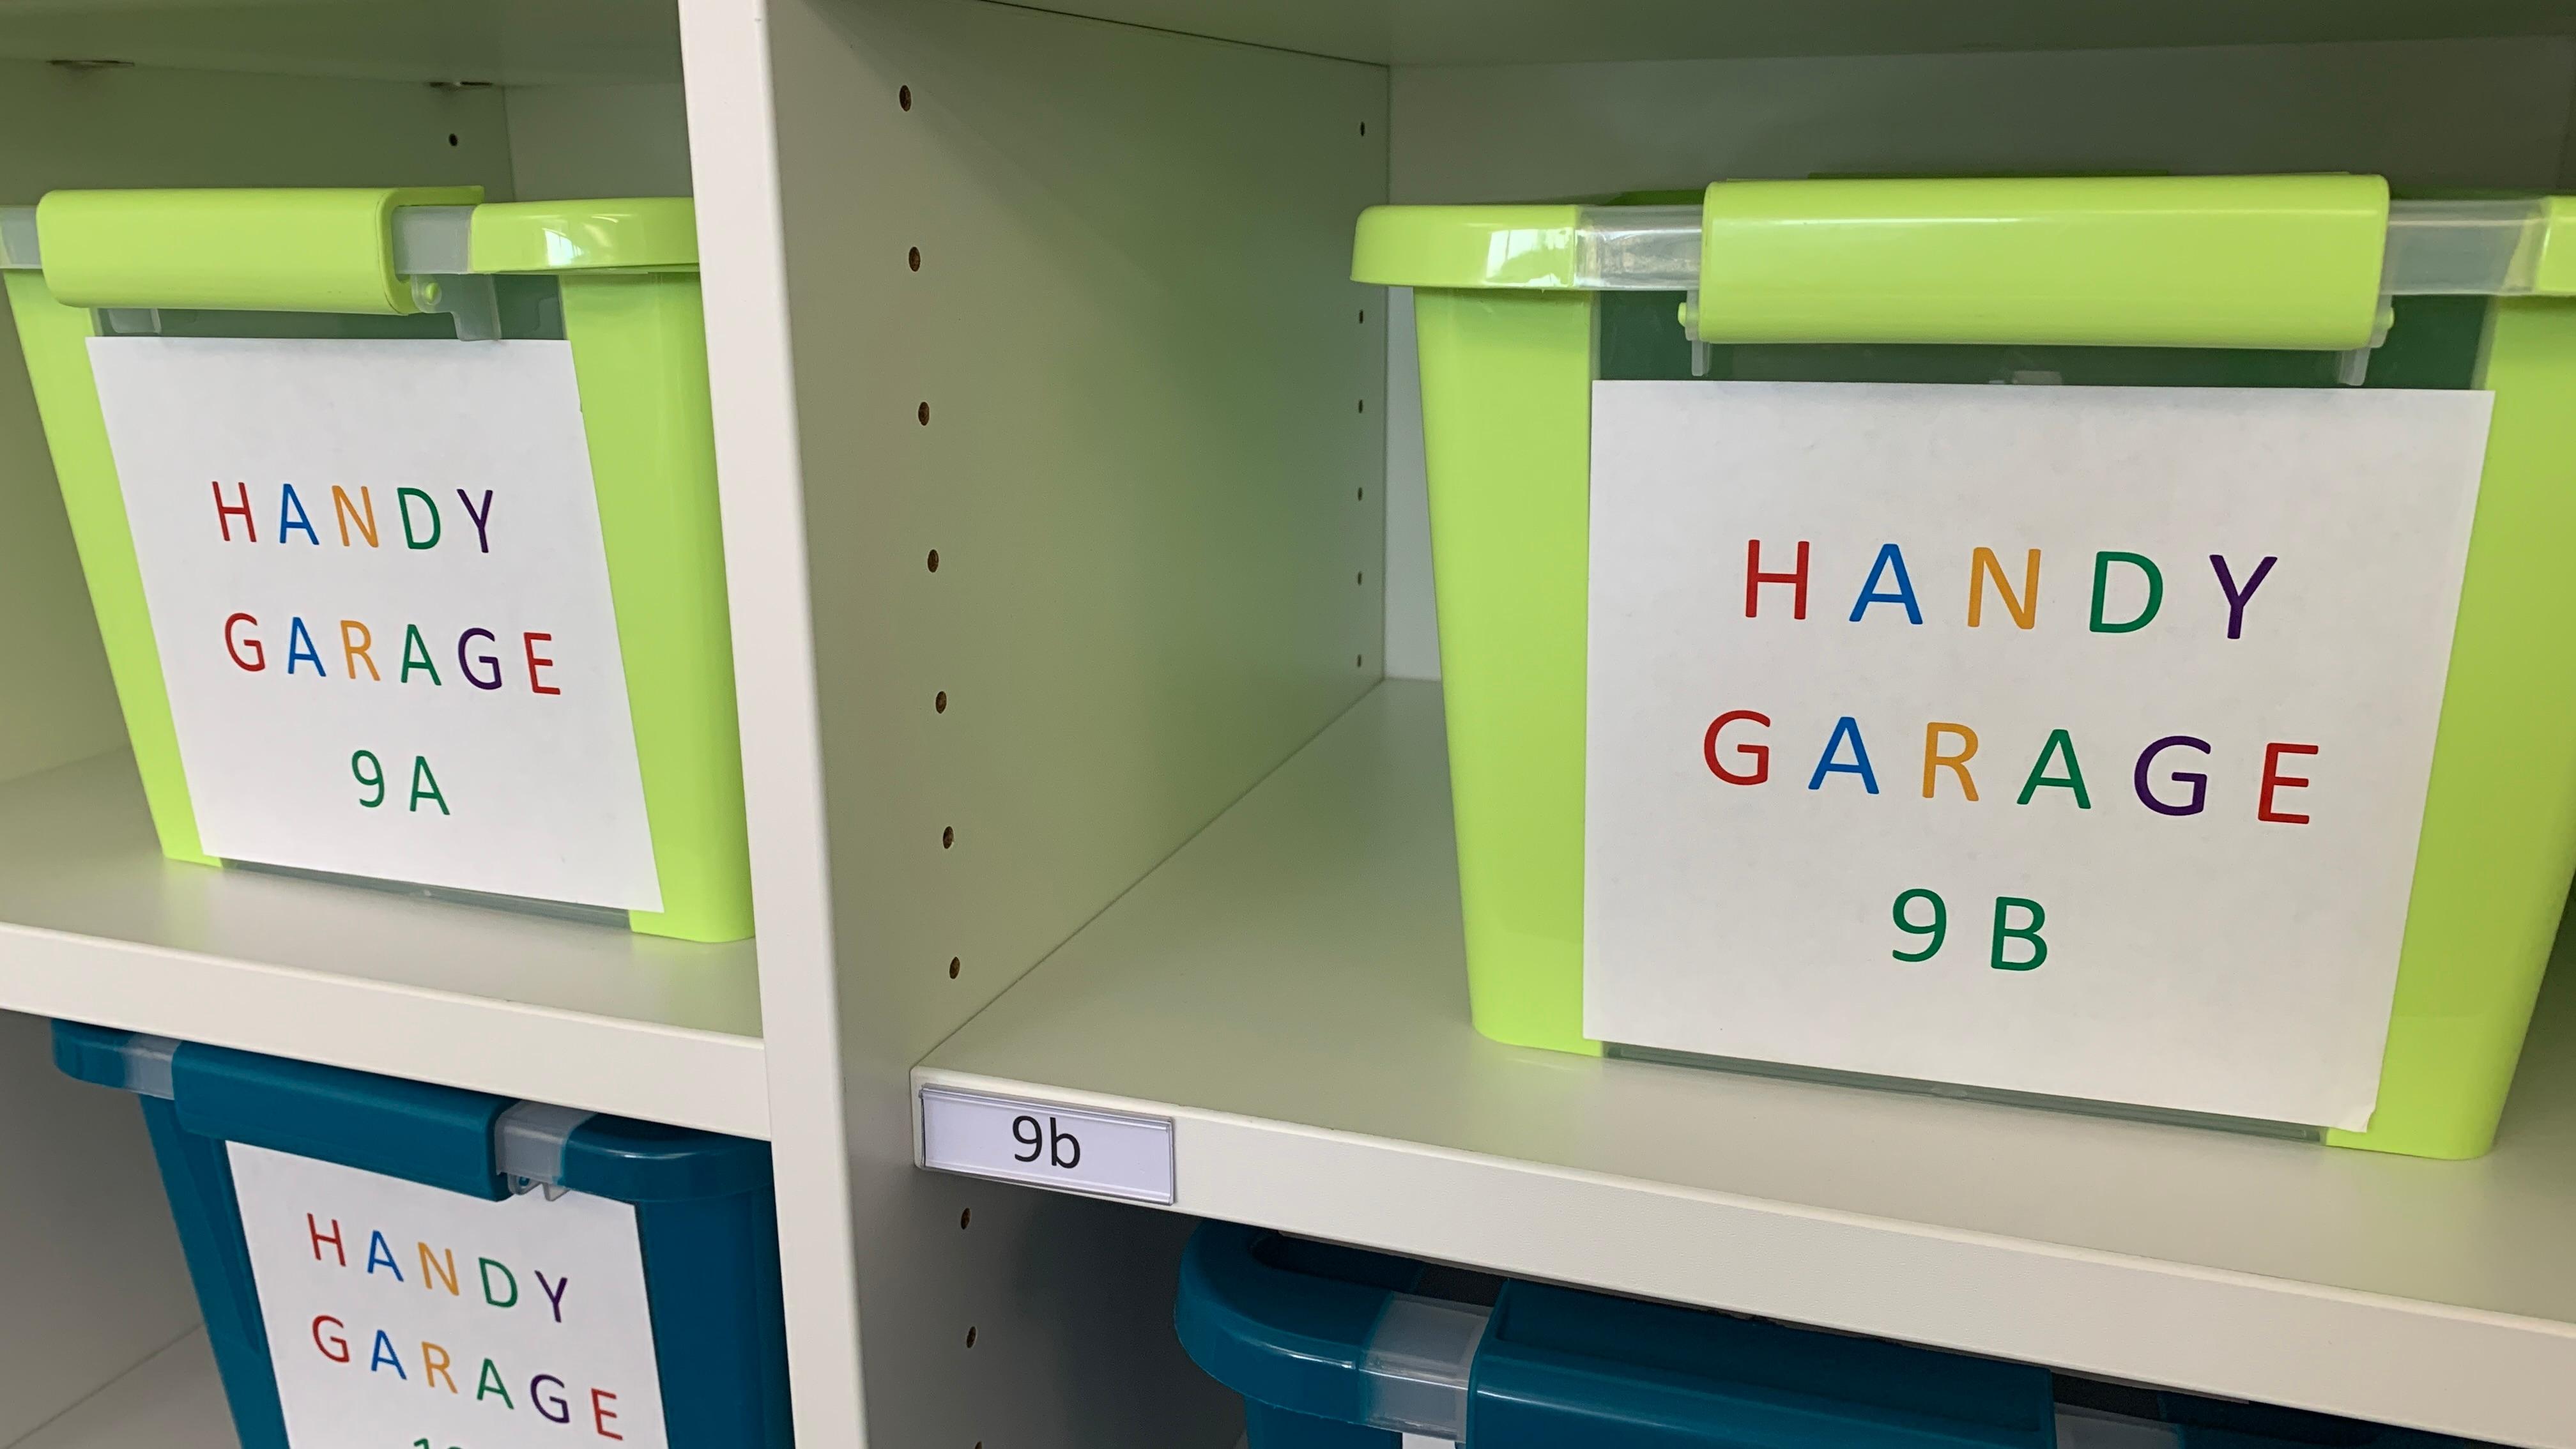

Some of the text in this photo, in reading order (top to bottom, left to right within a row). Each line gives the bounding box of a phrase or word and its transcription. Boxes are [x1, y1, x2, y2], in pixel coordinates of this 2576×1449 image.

[212, 481, 493, 553] HANDY
[1745, 539, 2278, 639] HANDY
[225, 613, 560, 695] GARAGE
[1704, 710, 2319, 824] GARAGE
[1013, 1116, 1080, 1169] 9b
[307, 1213, 567, 1322] HANDY
[312, 1315, 623, 1441] GARAGE
